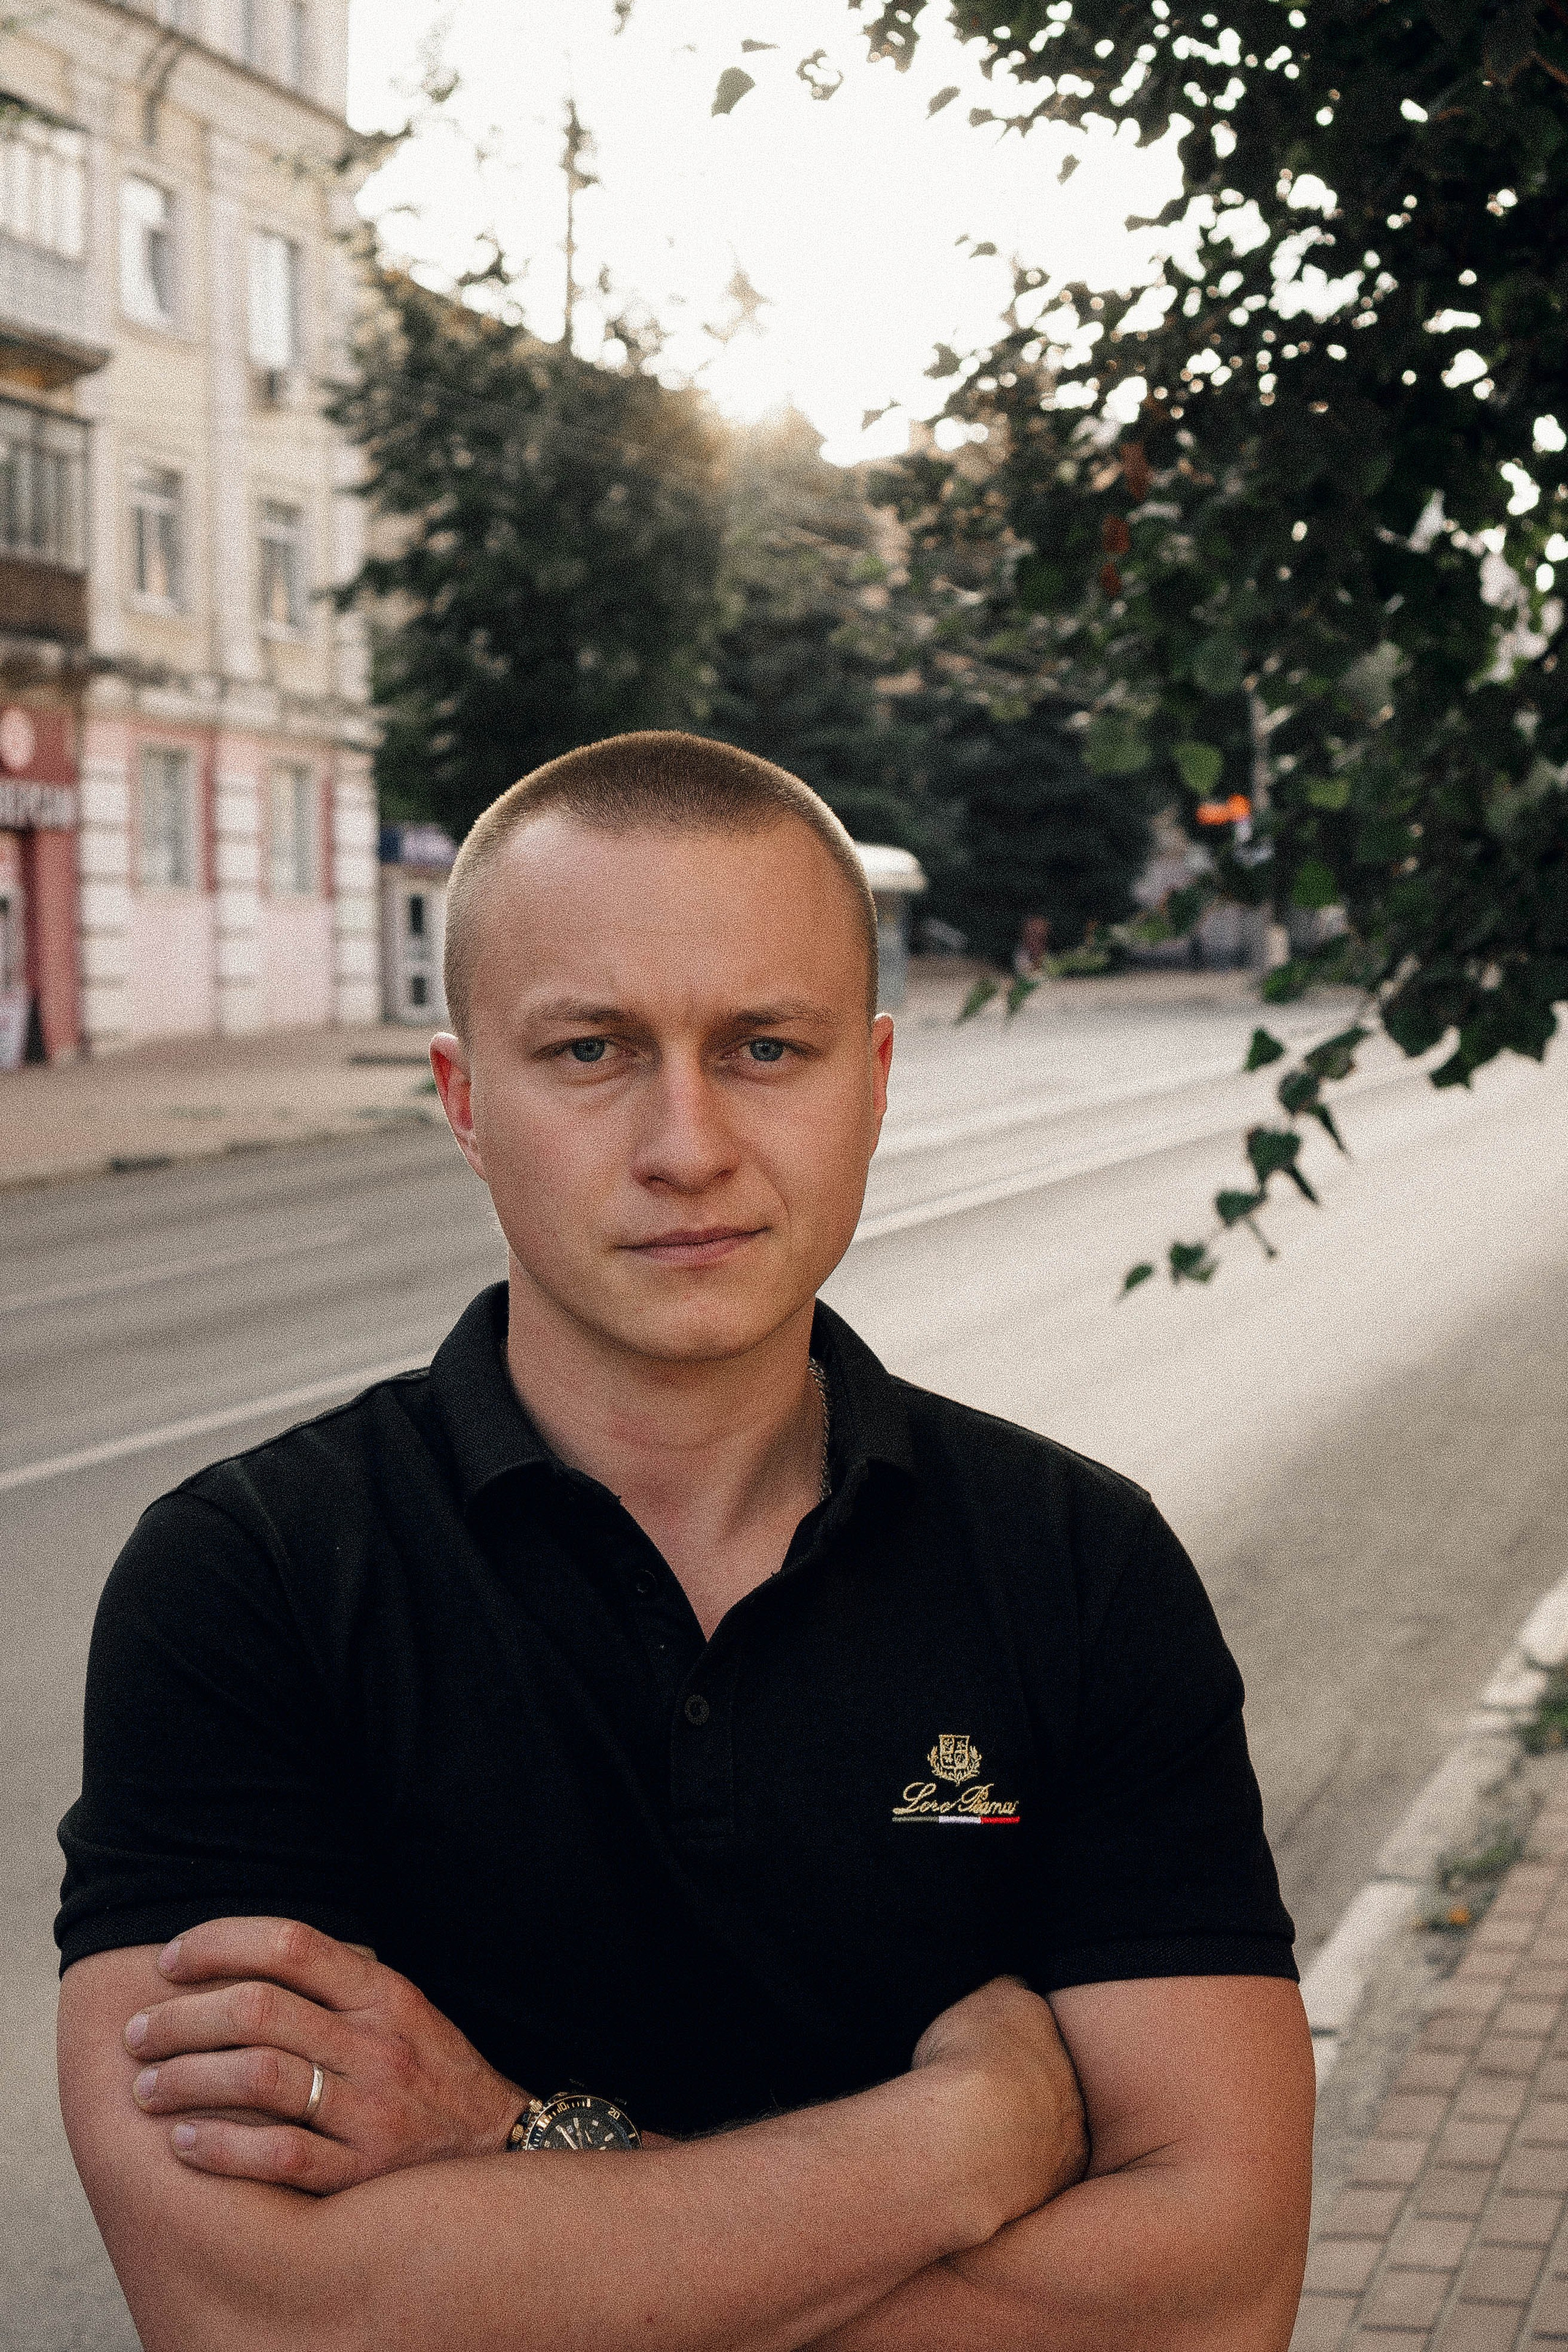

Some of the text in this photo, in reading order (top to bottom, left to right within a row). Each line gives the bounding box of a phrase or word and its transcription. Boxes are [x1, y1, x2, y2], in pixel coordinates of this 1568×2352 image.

[892, 1782, 960, 1814] Loro
[557, 2101, 567, 2112] 10
[608, 2106, 620, 2120] 20
